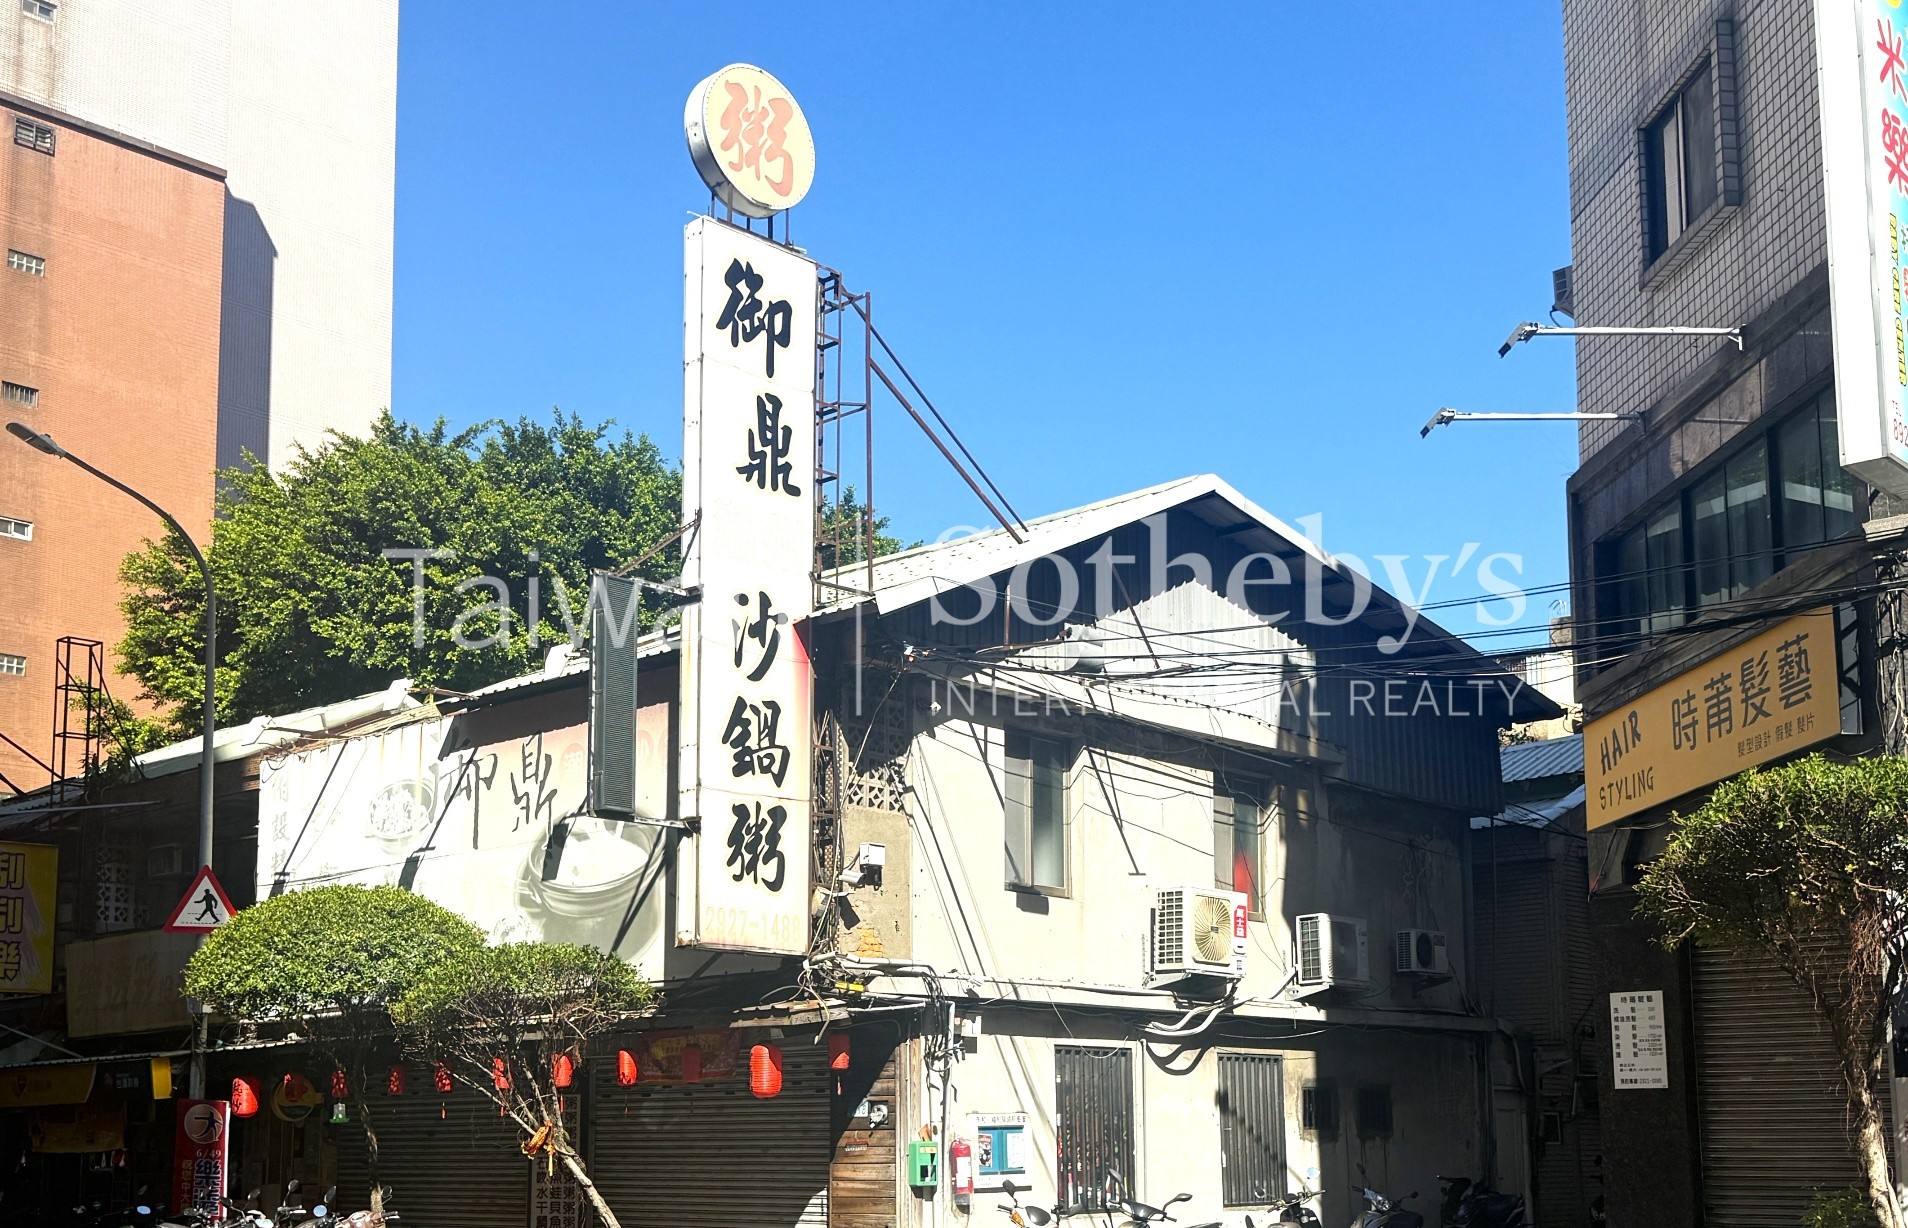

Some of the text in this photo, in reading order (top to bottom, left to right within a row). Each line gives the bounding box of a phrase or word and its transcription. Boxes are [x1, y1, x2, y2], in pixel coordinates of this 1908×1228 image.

[720, 80, 793, 197] 粥
[715, 258, 802, 893] 御鼎 沙鍋粥
[1672, 633, 1812, 751] 時莆髮藝
[1600, 710, 1642, 776] HAIR
[1599, 766, 1654, 811] STYLING
[181, 1159, 193, 1209] 祝您中大
[196, 1148, 222, 1160] 6/49
